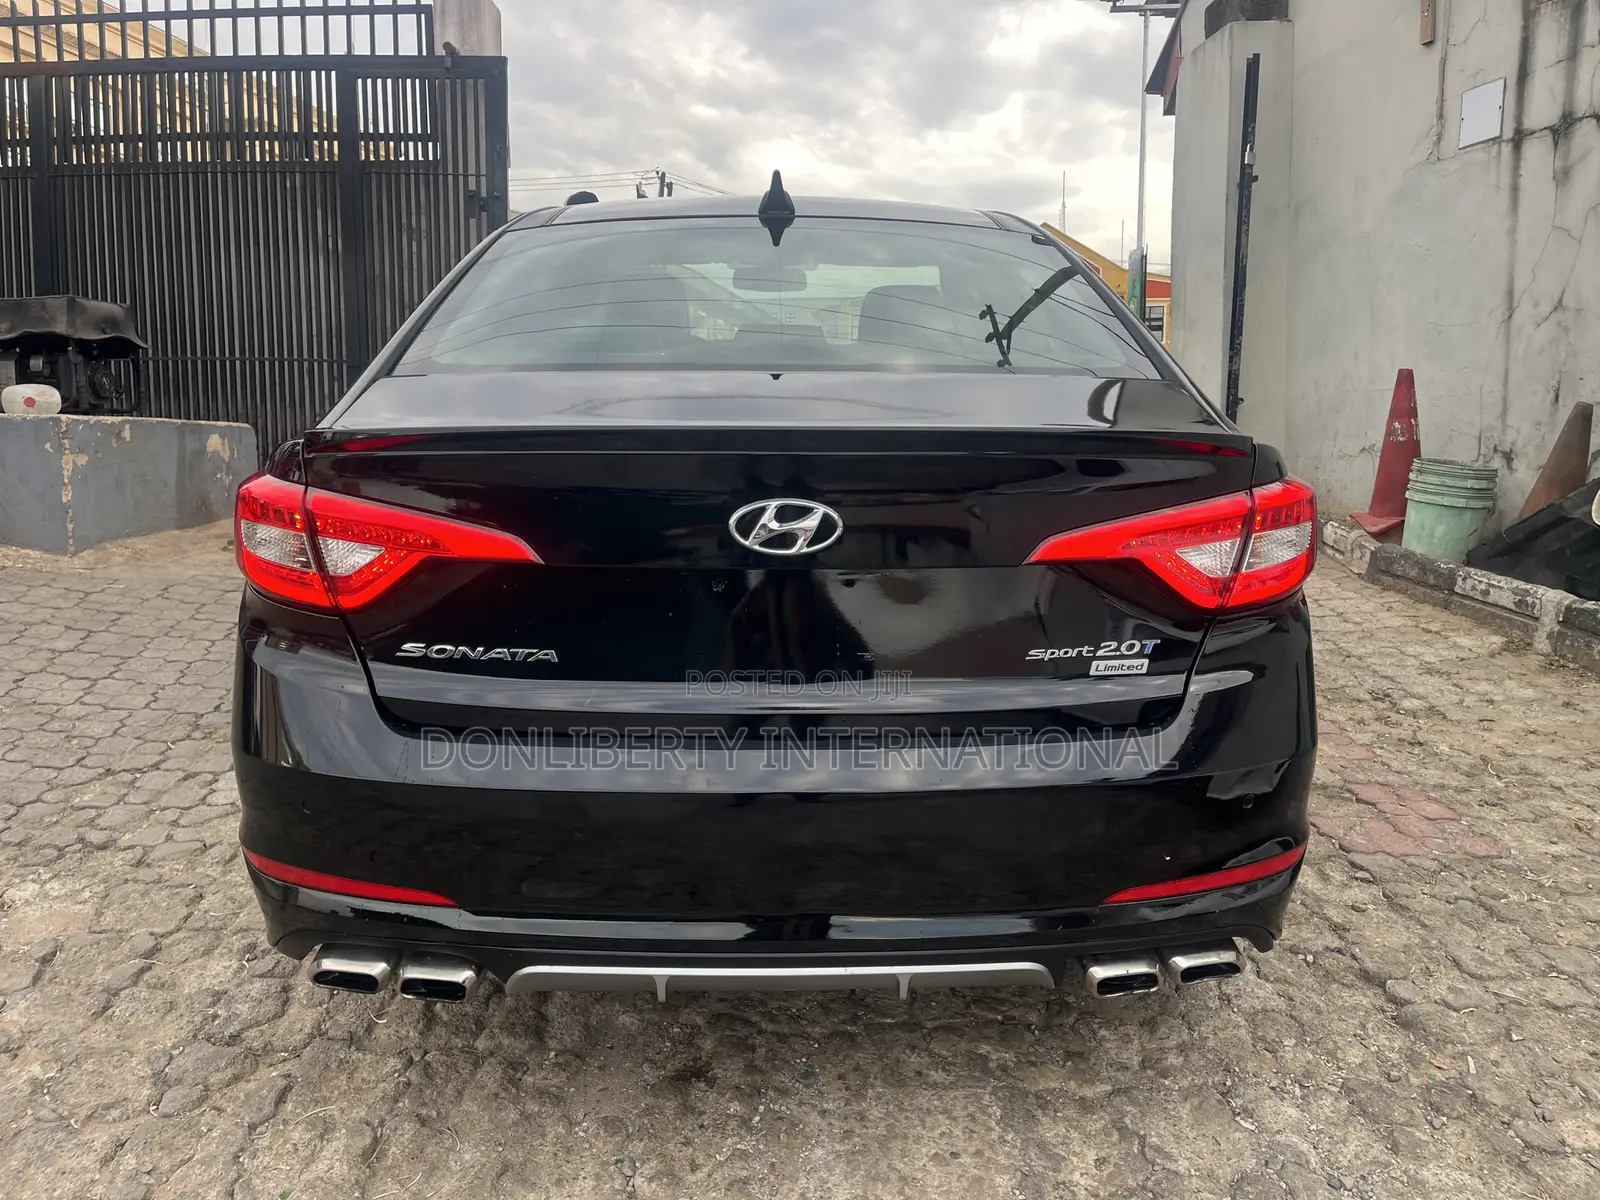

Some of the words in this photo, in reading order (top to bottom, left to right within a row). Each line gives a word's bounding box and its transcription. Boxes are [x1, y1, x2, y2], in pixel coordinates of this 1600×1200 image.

[395, 642, 558, 663] SONATA
[1095, 639, 1161, 656] 2.0T
[1094, 662, 1145, 673] Limited
